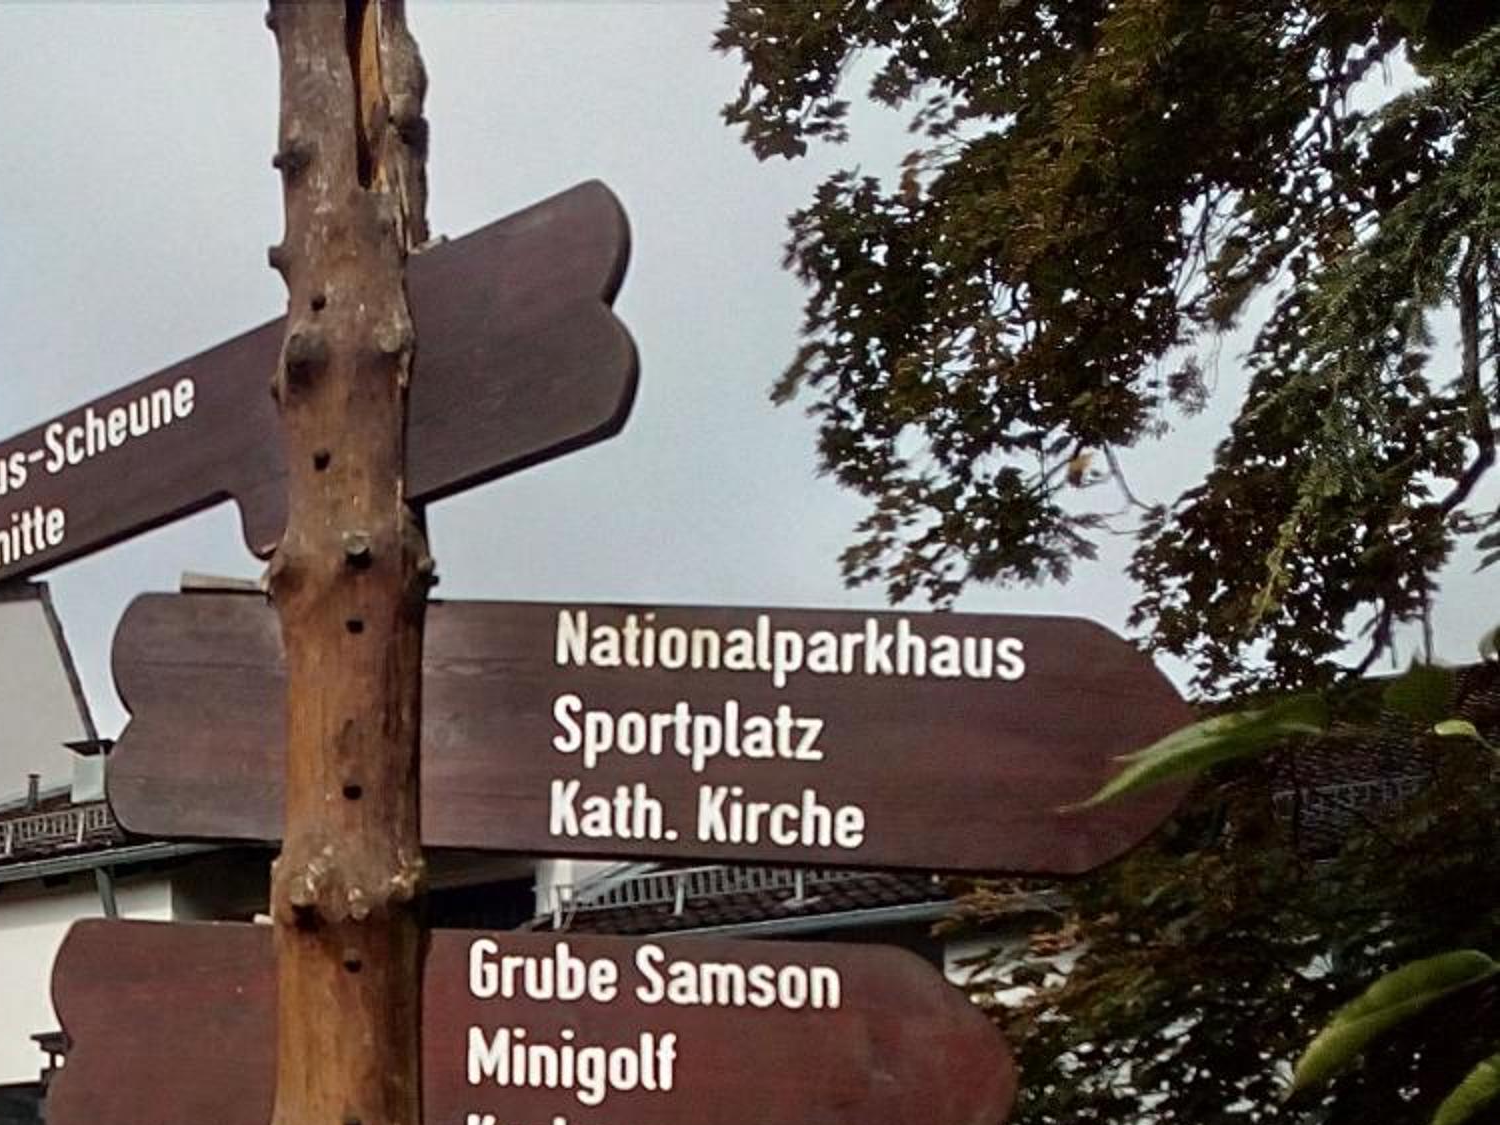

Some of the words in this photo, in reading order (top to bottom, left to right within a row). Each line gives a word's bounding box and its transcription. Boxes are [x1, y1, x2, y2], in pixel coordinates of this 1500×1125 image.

[555, 609, 1026, 688] Nationalparkhaus
[552, 694, 824, 772] Sportplatz
[549, 780, 679, 841] Kath.
[697, 784, 866, 849] Kirche
[469, 938, 618, 1002] Grube
[635, 944, 841, 1009] Samson
[467, 1026, 677, 1105] Minigolf
